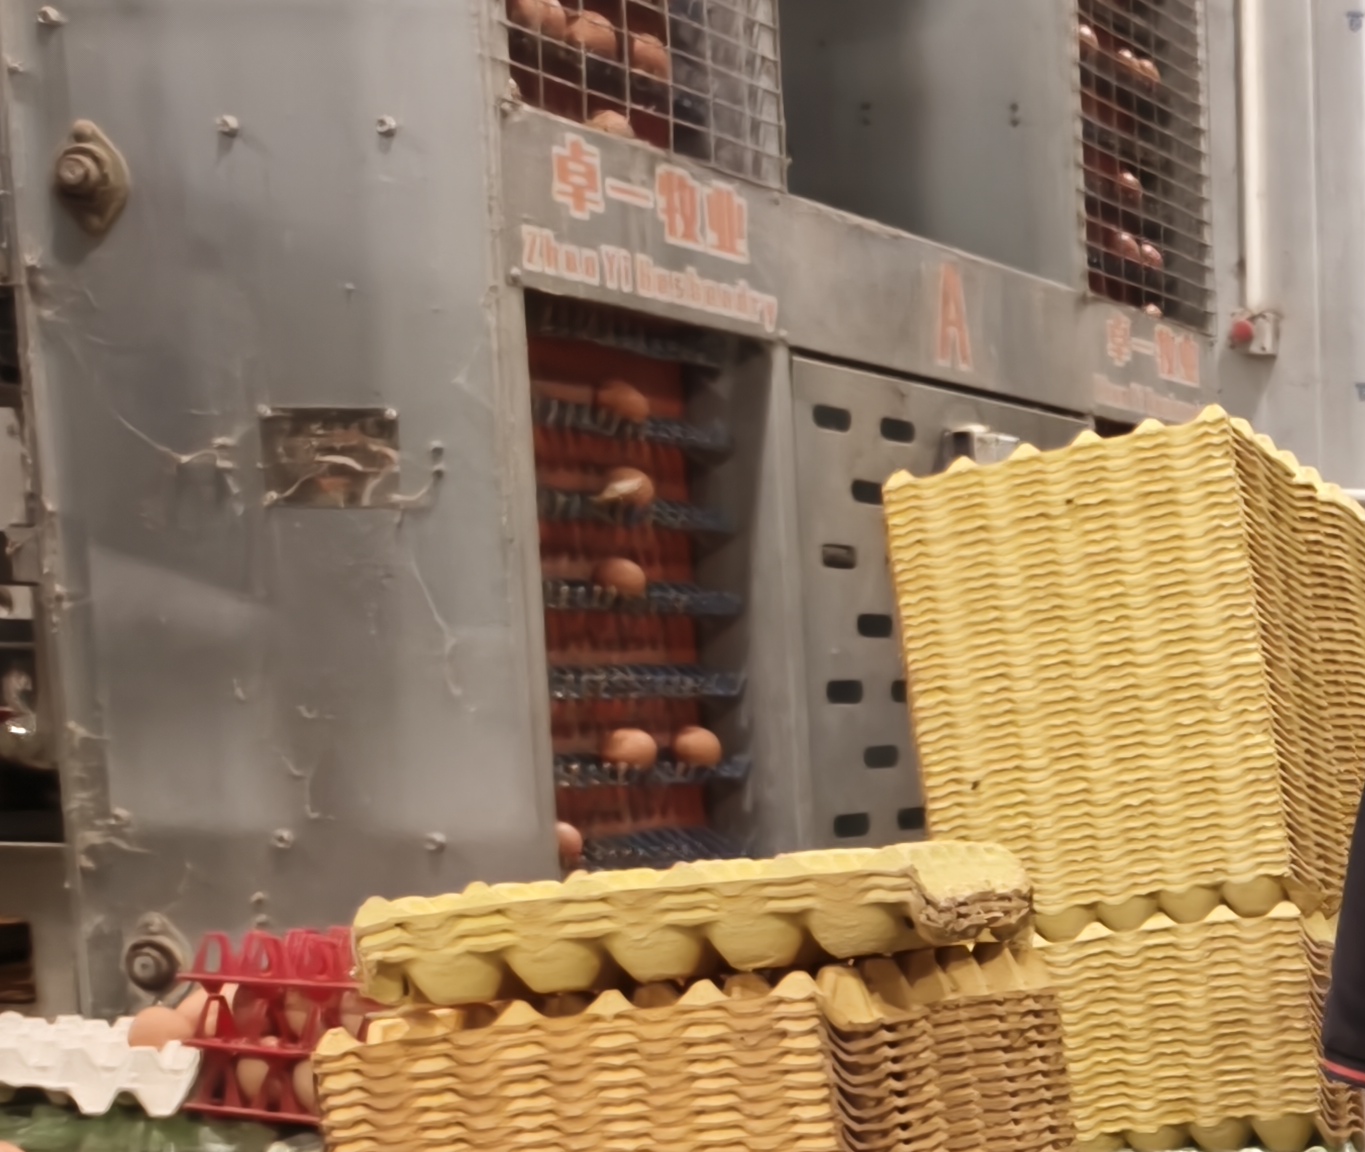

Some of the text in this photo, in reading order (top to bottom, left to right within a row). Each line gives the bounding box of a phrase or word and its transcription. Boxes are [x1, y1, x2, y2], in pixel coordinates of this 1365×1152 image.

[553, 133, 748, 263] 卓一牧业
[935, 260, 973, 371] A
